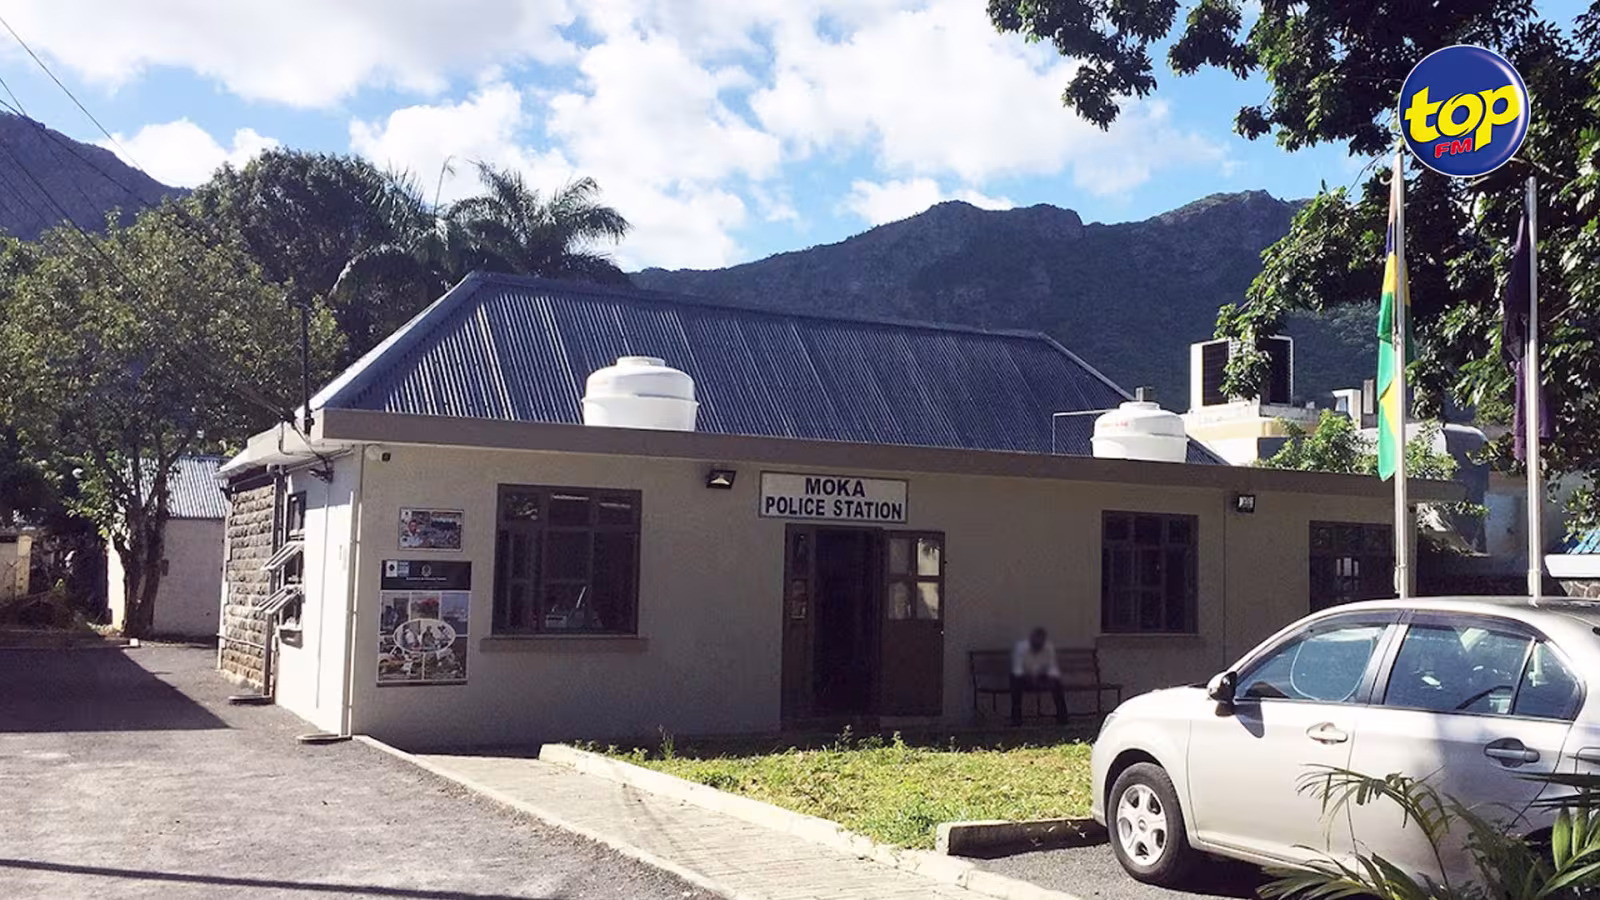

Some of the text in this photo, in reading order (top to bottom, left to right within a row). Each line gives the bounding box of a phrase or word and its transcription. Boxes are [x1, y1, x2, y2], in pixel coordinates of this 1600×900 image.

[805, 477, 865, 497] MOKA
[765, 496, 902, 520] POLICE STATION
